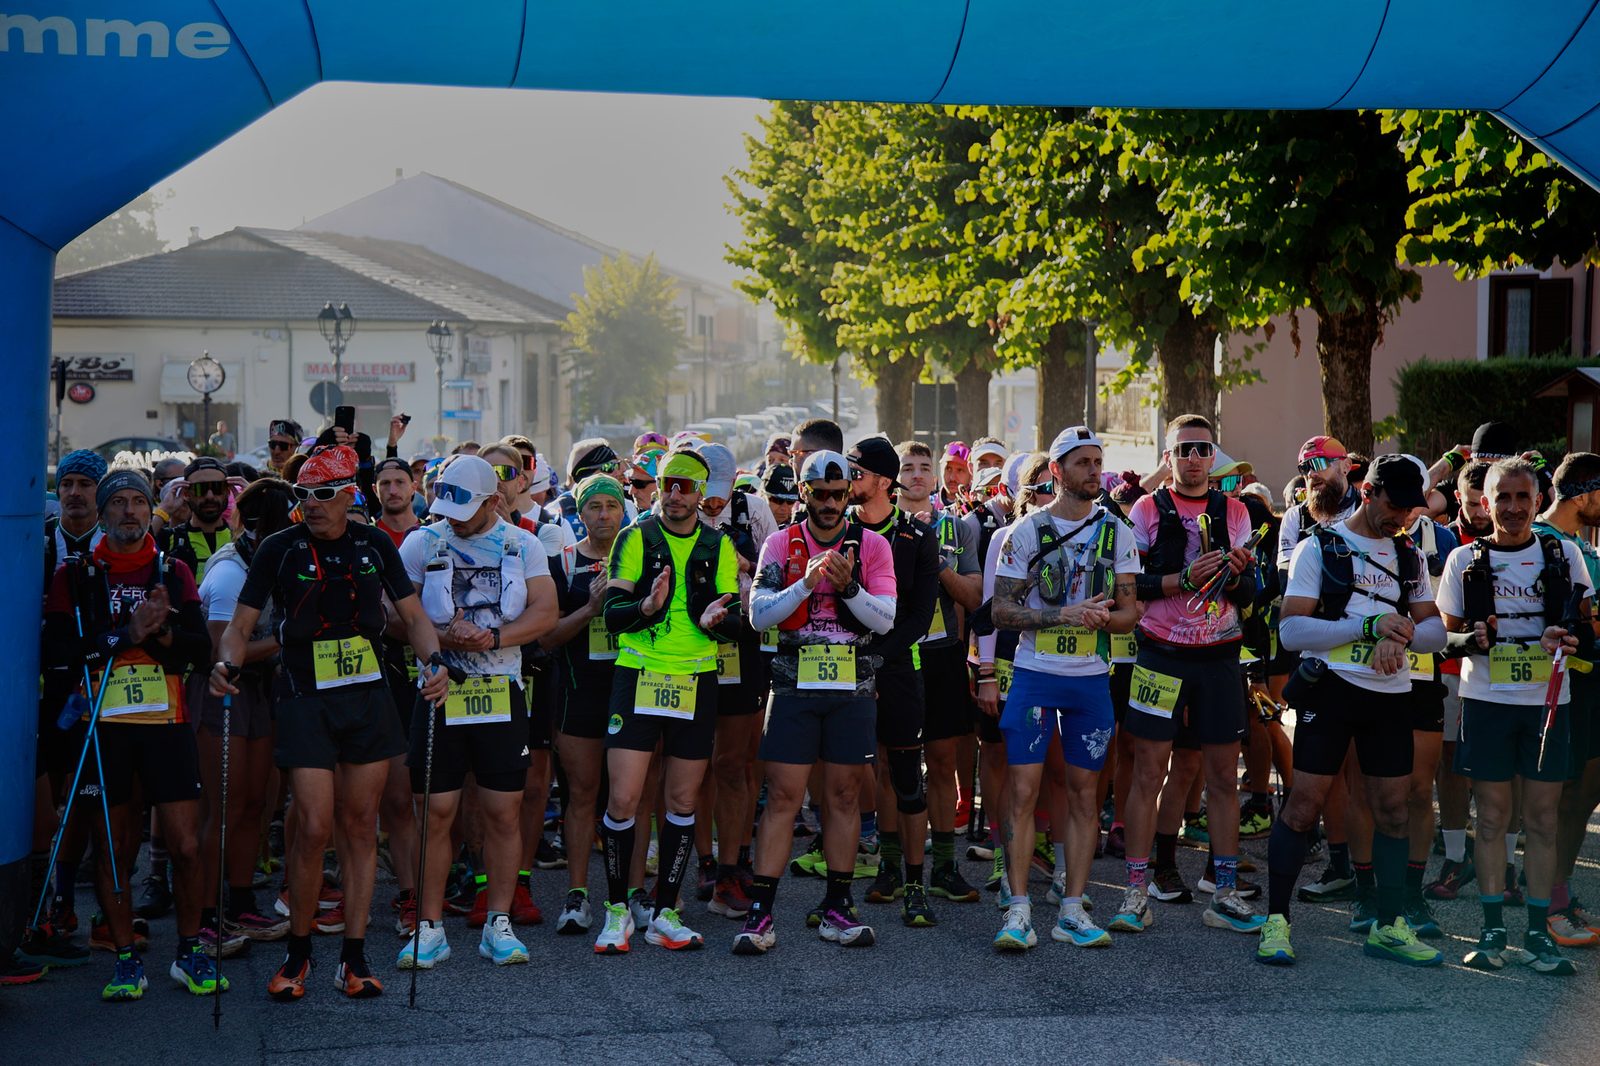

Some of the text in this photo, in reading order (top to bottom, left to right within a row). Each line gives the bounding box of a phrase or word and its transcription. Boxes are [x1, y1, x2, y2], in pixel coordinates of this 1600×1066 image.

[1057, 636, 1077, 654] 88
[1128, 641, 1136, 656] 9
[1350, 644, 1374, 664] 57
[334, 654, 363, 677] 167
[818, 662, 838, 680] 53
[1511, 662, 1532, 682] 56
[123, 683, 144, 704] 15
[654, 688, 680, 708] 185
[1137, 684, 1161, 705] 104
[463, 695, 492, 715] 100
